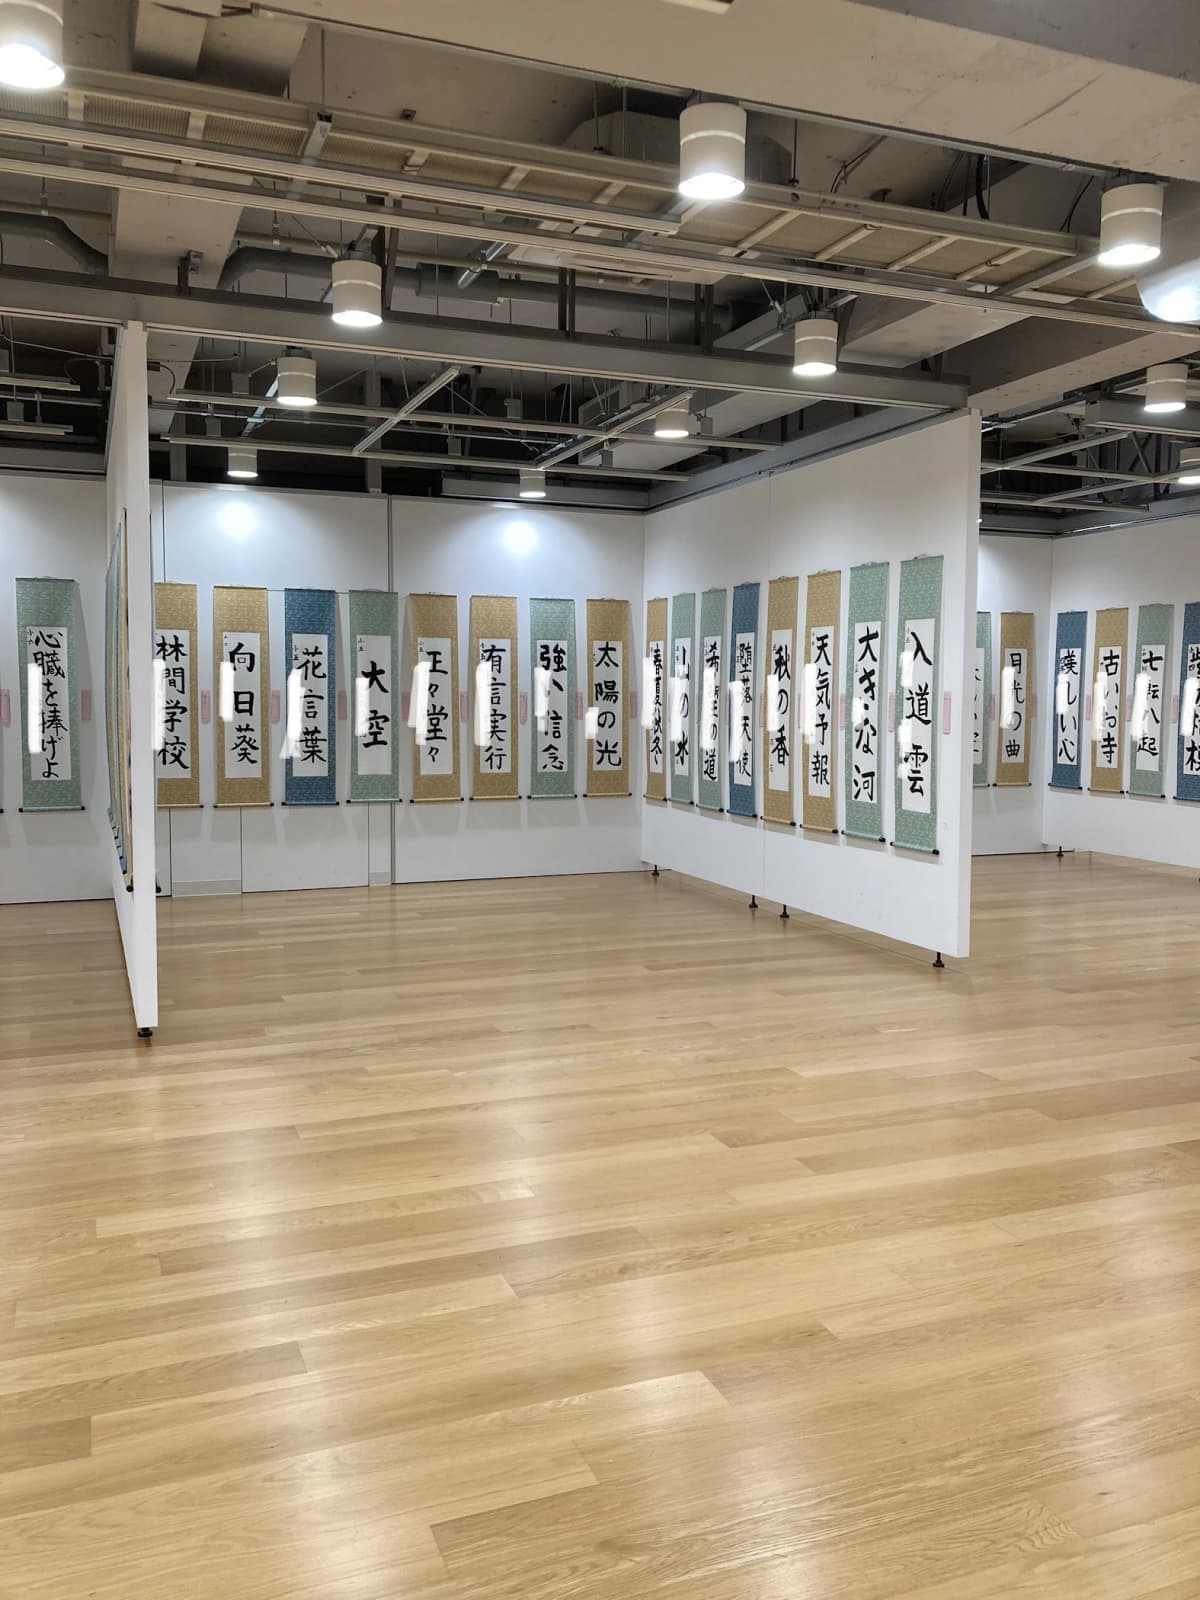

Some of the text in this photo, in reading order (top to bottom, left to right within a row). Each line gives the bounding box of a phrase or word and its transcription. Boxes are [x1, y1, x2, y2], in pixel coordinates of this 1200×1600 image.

[154, 635, 190, 770] 林間学校
[228, 642, 260, 764] 向日葵
[296, 645, 328, 764] 花言葉
[361, 660, 390, 749] 大空
[482, 644, 508, 771] 有言実行
[594, 641, 623, 768] 太陽の光
[771, 644, 792, 767] 秋の香
[811, 633, 832, 786] 天気予報
[853, 625, 880, 802] 大きな河
[903, 630, 933, 798] 入道雲
[1058, 648, 1079, 763] 美しい心
[1137, 650, 1163, 757] 七転八起
